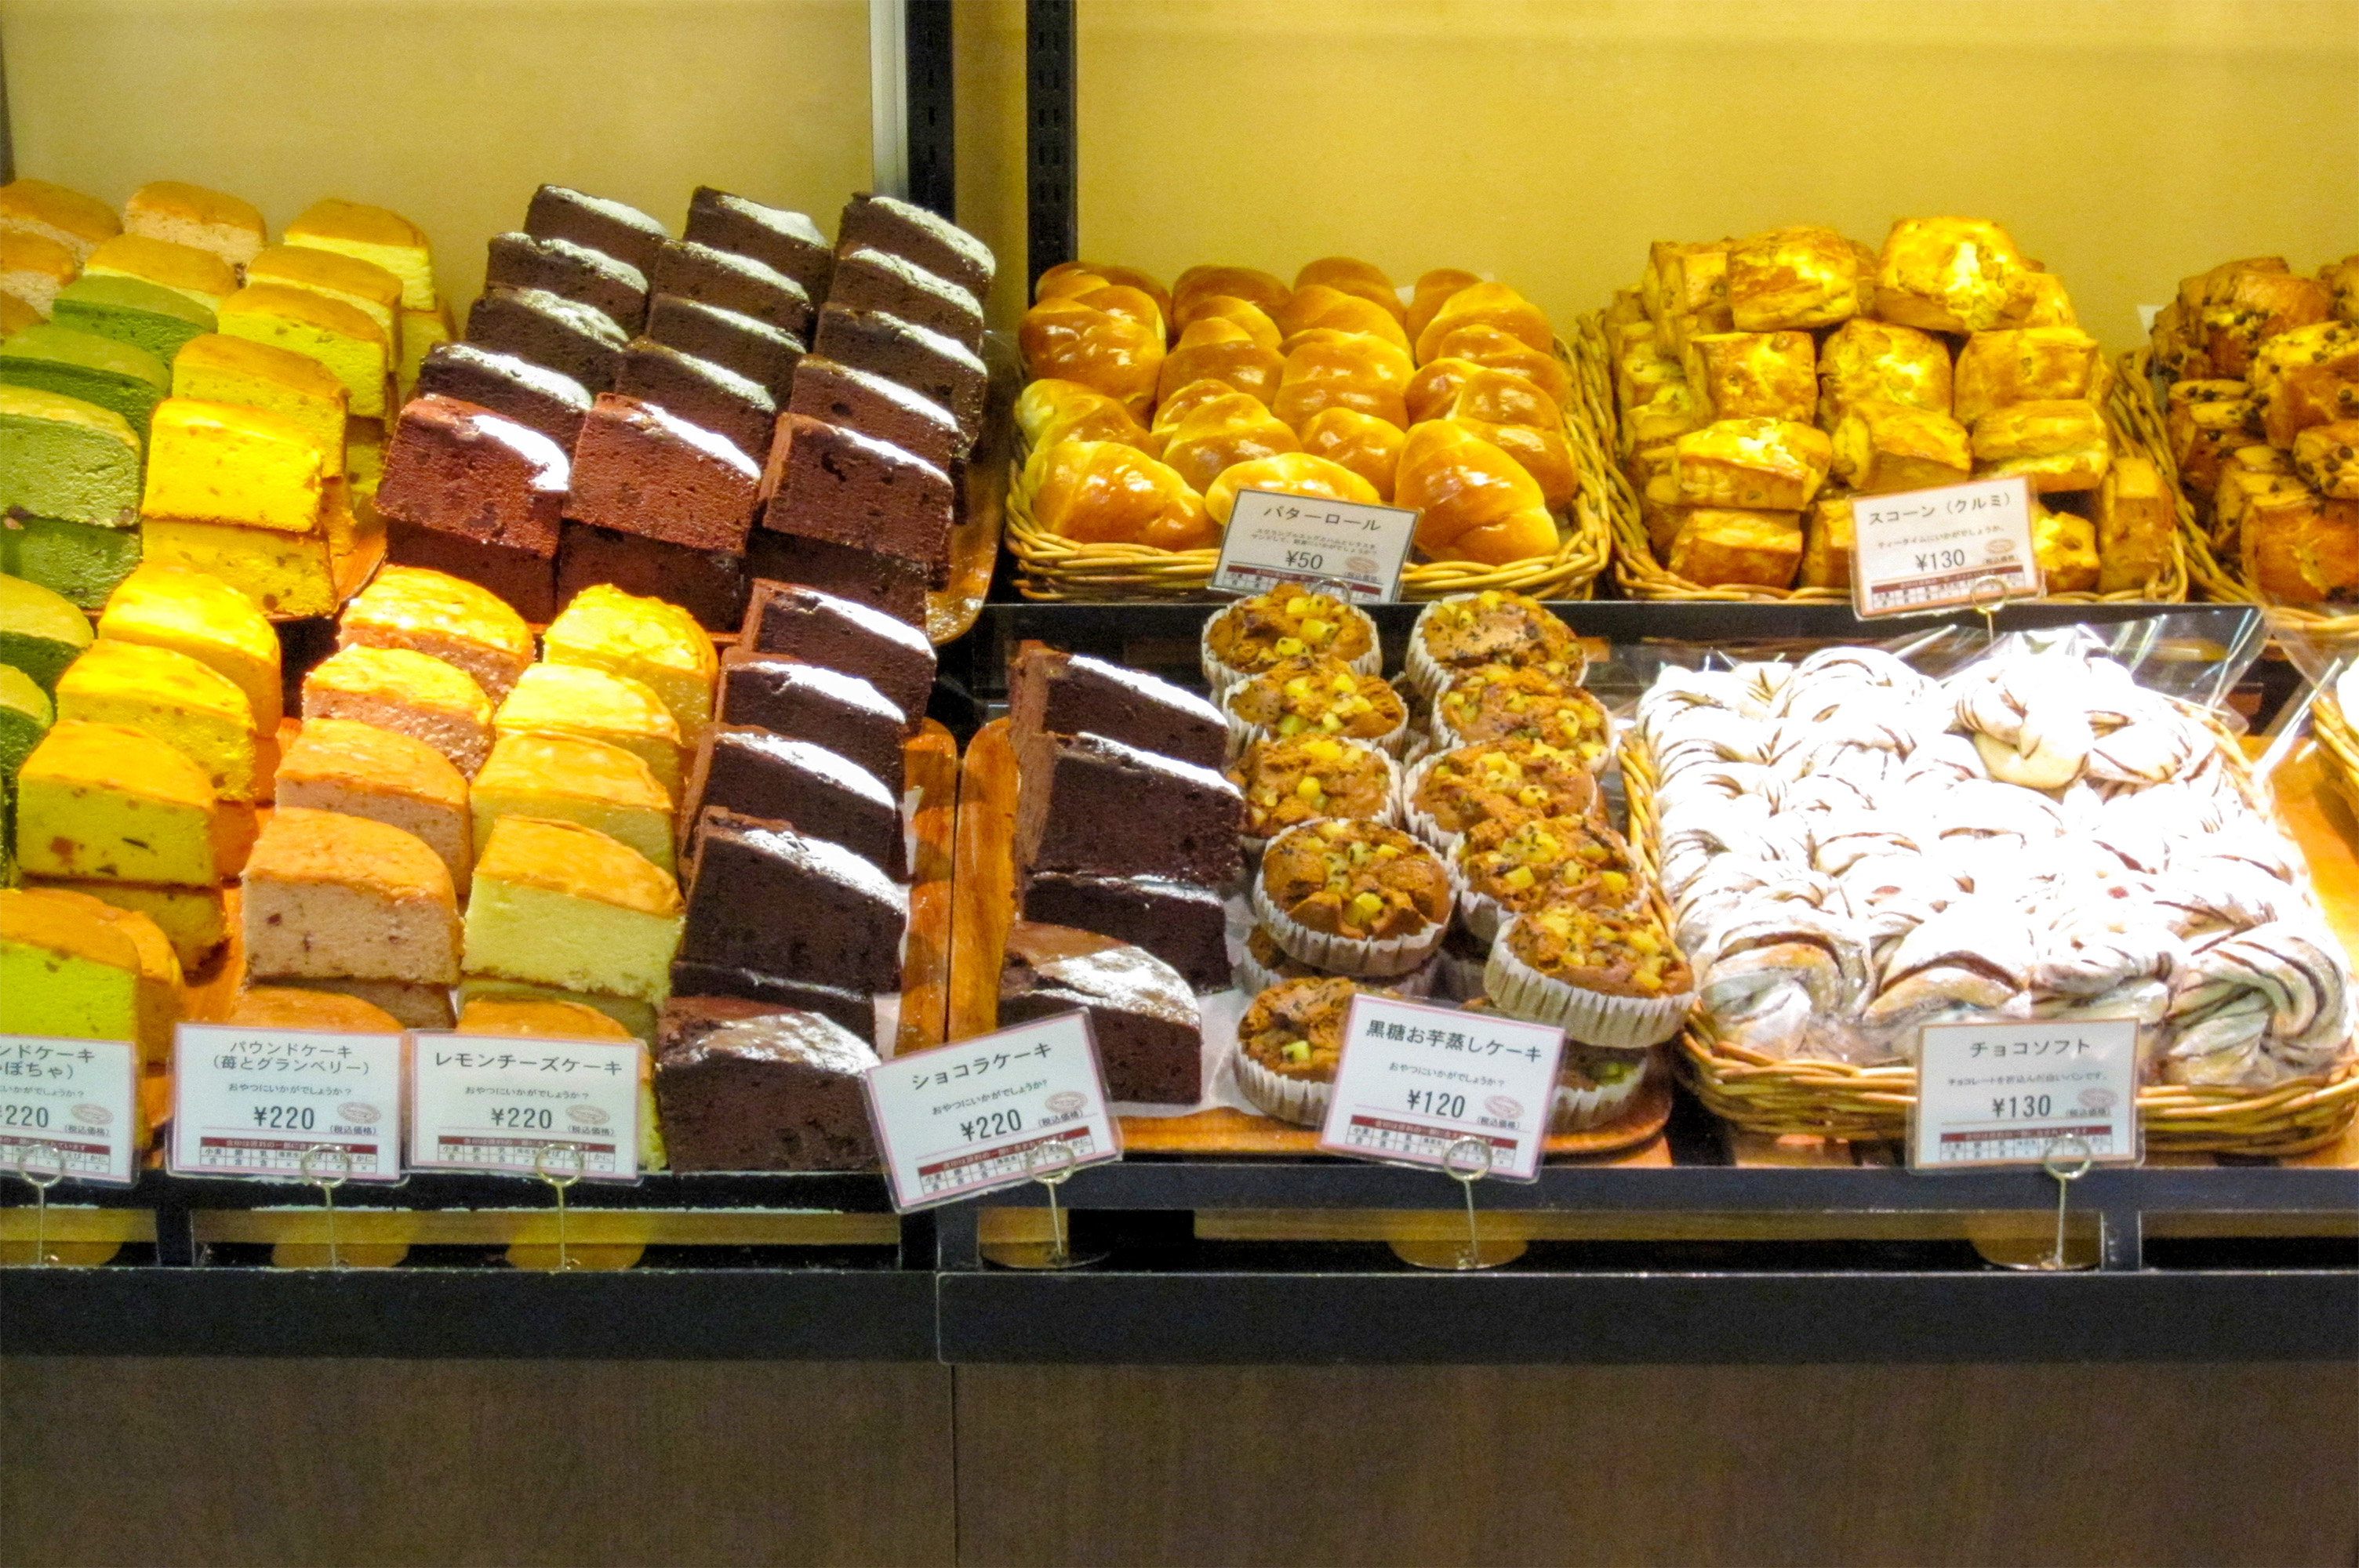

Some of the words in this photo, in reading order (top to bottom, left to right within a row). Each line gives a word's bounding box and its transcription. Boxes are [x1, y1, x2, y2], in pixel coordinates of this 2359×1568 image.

[1264, 505, 1380, 532] バターロール
[1869, 492, 2011, 526] スコーン（クルミ）
[1285, 550, 1323, 570] ¥50
[1915, 548, 1965, 572] ¥130
[230, 1040, 352, 1059] パウンドケーキ
[1366, 1018, 1543, 1063] 黒糖お芋蒸しケーキ
[1970, 1038, 2090, 1058] チョコソフト
[434, 1052, 623, 1076] レモンチーズケーキ
[911, 1041, 1052, 1091] ショコラケーキ
[1407, 1089, 1466, 1118] ¥120
[1992, 1094, 2051, 1118] ¥130
[0, 1105, 49, 1128] 220
[254, 1105, 314, 1130] ¥220
[491, 1108, 552, 1129] ¥220
[960, 1109, 1022, 1142] ¥220
